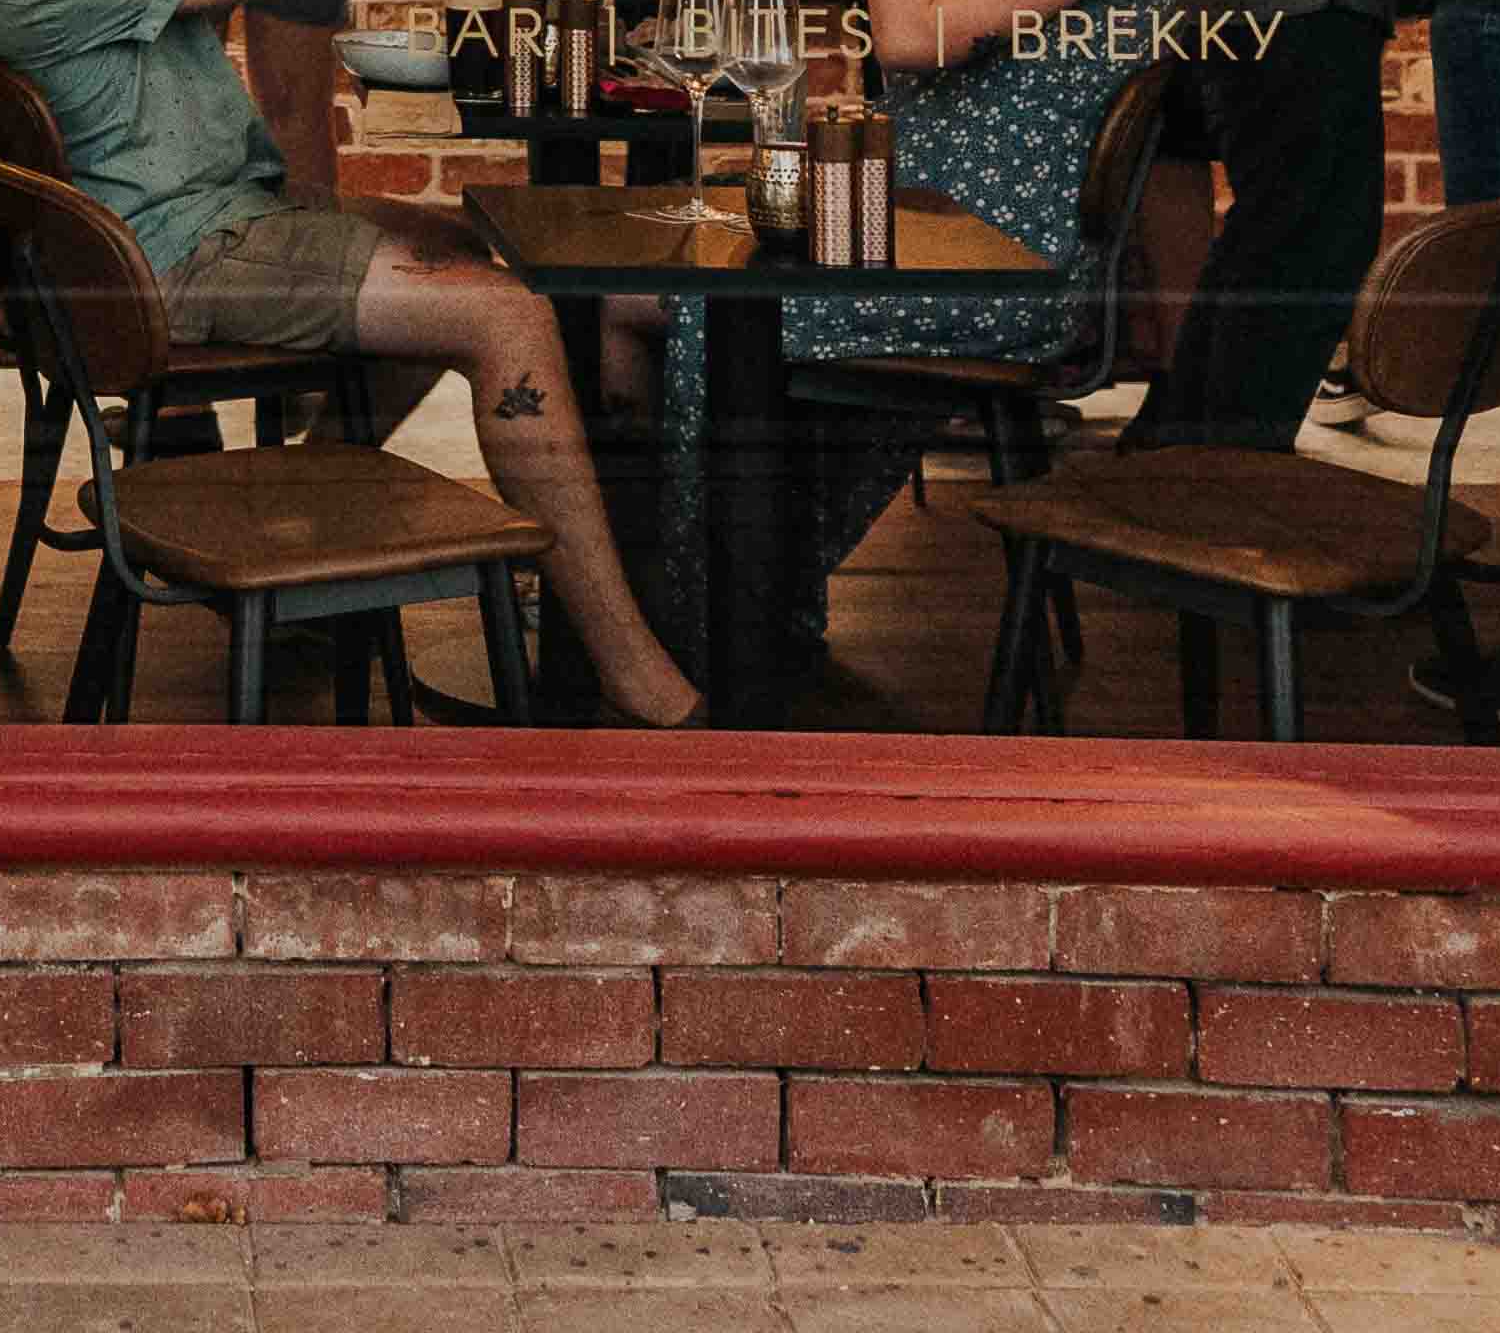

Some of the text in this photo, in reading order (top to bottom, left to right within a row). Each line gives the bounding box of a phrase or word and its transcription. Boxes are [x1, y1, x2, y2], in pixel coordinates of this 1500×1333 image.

[408, 6, 1286, 62] BAR BITES BREKKY
